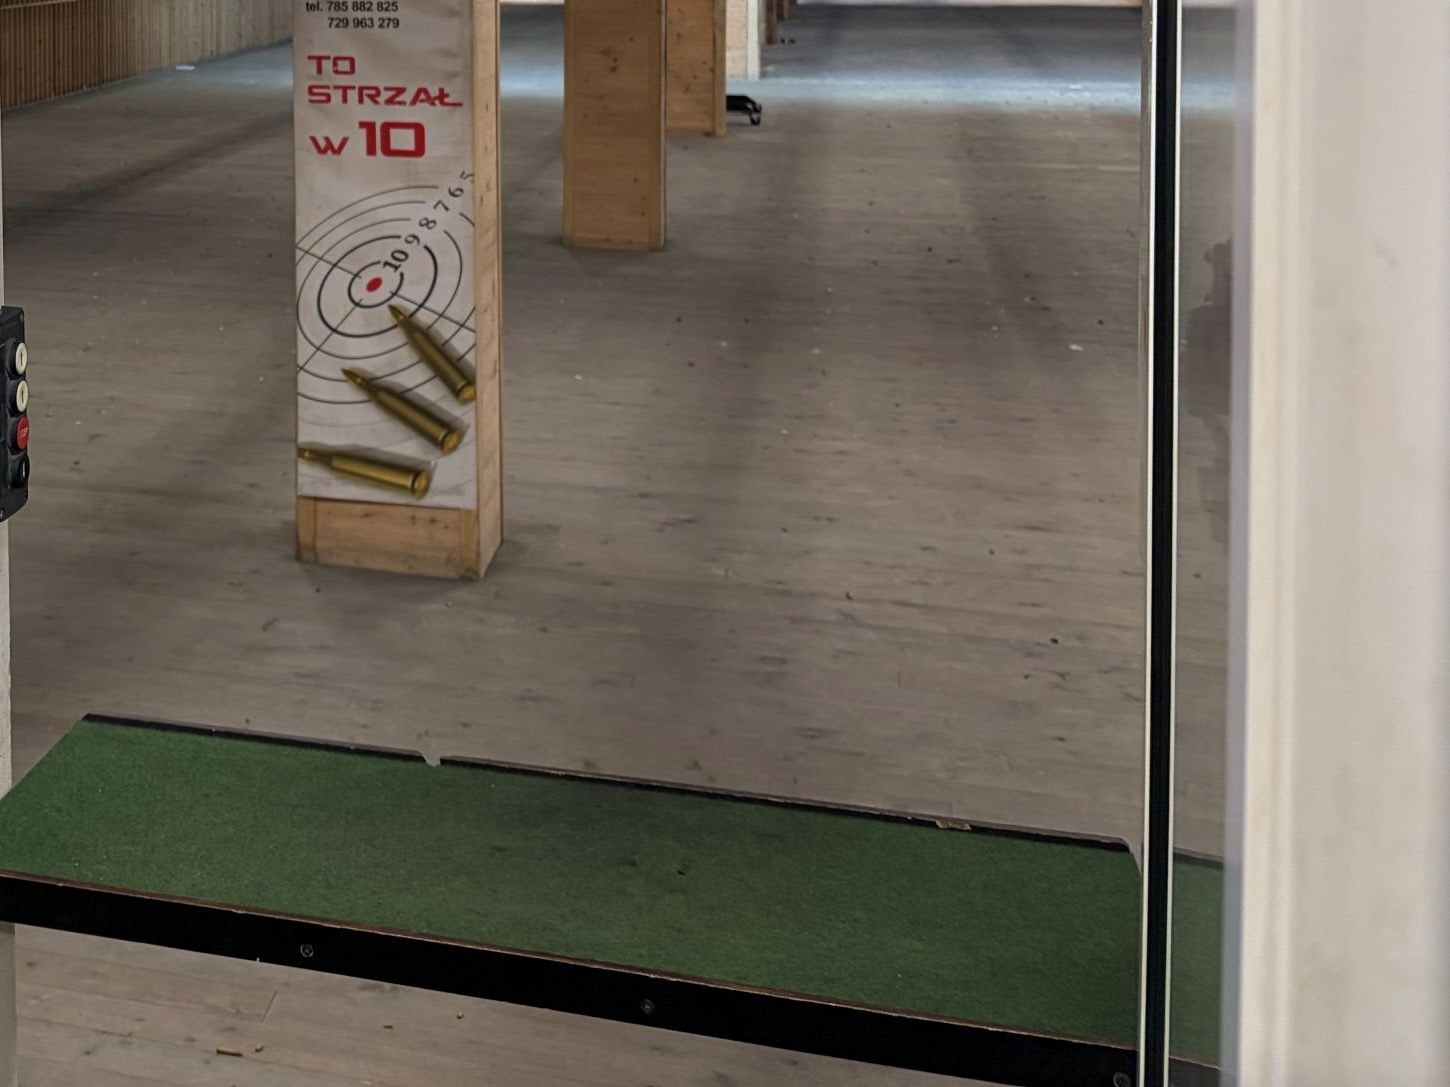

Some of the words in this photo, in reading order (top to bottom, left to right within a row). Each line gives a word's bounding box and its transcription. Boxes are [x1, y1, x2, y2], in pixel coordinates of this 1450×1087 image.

[305, 1, 323, 12] tel.
[327, 1, 348, 12] 785
[352, 1, 373, 12] 882
[377, 1, 398, 12] 825
[327, 17, 349, 29] 729
[352, 17, 374, 29] 963
[378, 17, 400, 29] 279
[307, 55, 356, 75] TO
[307, 85, 463, 108] STRZAŁ
[309, 135, 350, 156] w
[358, 121, 426, 159] 10
[383, 249, 409, 273] 10
[404, 234, 420, 246] 9
[418, 217, 437, 230] 8
[433, 200, 449, 212] 7
[448, 186, 464, 198] 6
